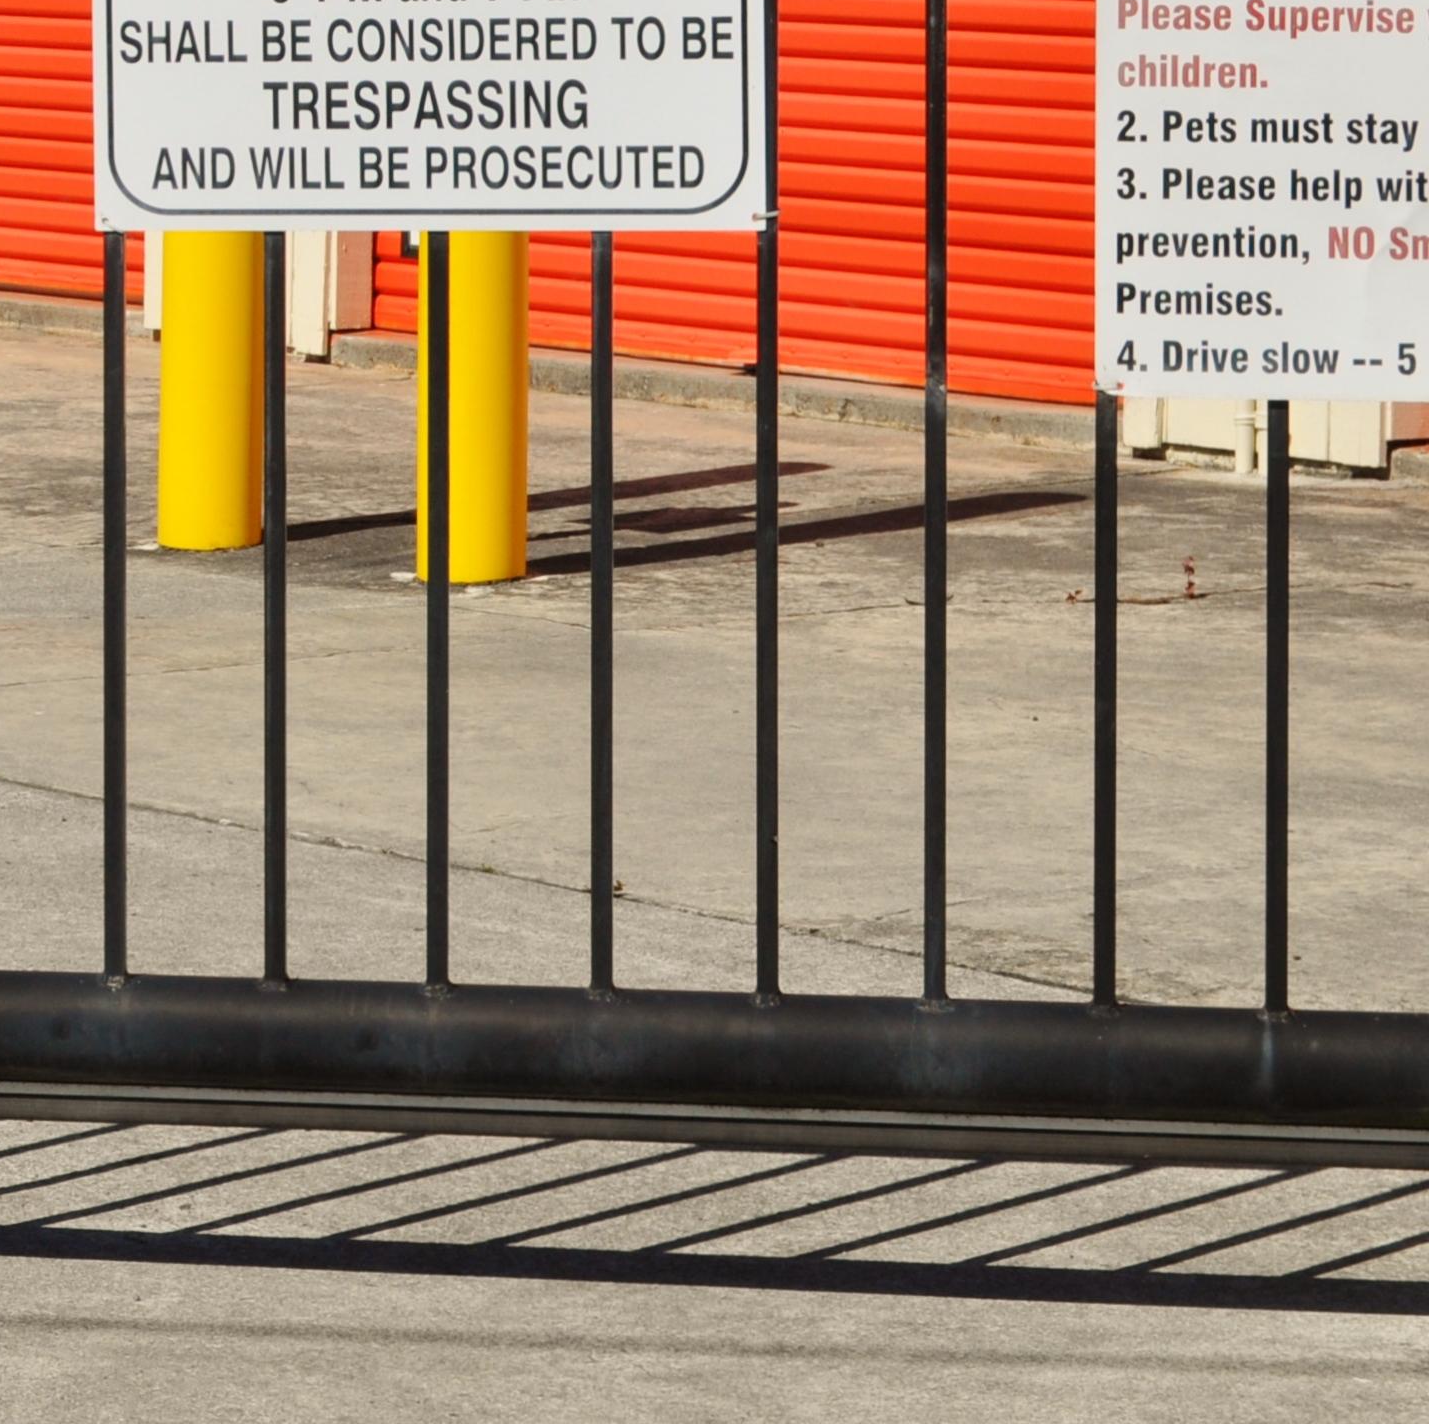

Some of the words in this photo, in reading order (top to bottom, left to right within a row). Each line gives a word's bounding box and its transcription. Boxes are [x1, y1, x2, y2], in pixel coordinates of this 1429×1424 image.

[121, 21, 247, 63] SHALL
[263, 20, 312, 62] BE
[328, 18, 596, 62] CONSIDERED
[611, 17, 665, 60] TO
[683, 17, 733, 59] BE
[1118, 55, 1268, 88] children.
[263, 79, 587, 130] TRESPASSING
[1118, 110, 1147, 142] 2.
[1163, 111, 1236, 143] Pets
[1251, 113, 1333, 143] must
[1347, 114, 1418, 152] stay
[153, 148, 235, 189] AND
[249, 147, 344, 189] WILL
[360, 147, 409, 189] BE
[426, 146, 704, 189] PROSECUTED
[1117, 168, 1146, 199] 3.
[1163, 168, 1275, 200] Please
[1291, 169, 1362, 209] help
[1117, 226, 1309, 264] prevention,
[1329, 227, 1374, 259] NO
[1117, 283, 1282, 316] Premises.
[1117, 341, 1147, 371] 4.
[1163, 341, 1248, 373] Drive
[1262, 342, 1338, 374] slow
[1398, 343, 1416, 375] 5
